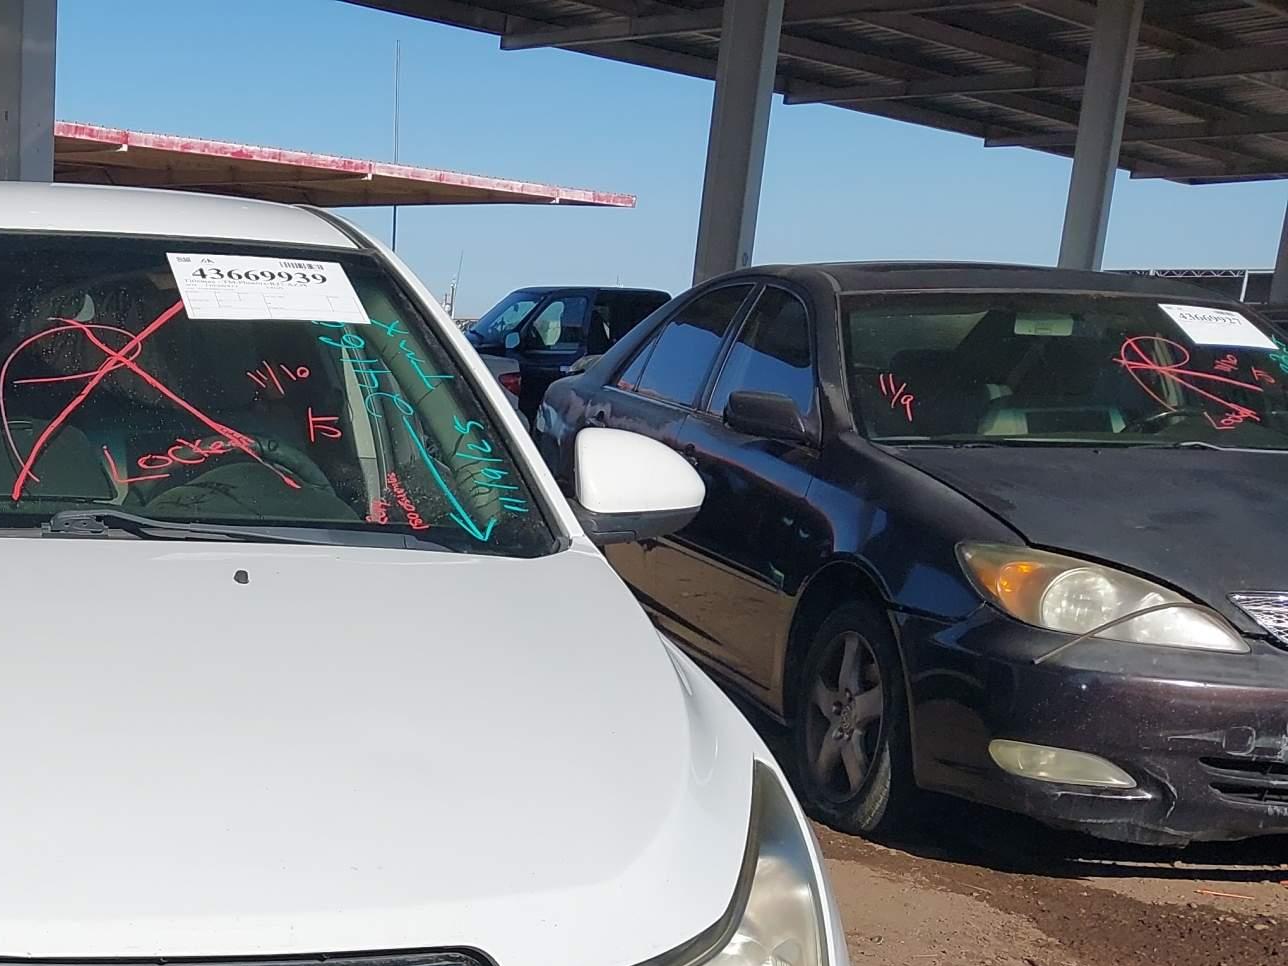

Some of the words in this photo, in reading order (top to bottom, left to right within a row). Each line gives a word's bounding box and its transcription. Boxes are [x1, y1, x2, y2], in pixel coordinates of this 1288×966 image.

[192, 267, 328, 285] 43669939
[246, 360, 310, 395] 11/10
[879, 373, 914, 422] 11/9
[454, 415, 529, 512] 11/9/25
